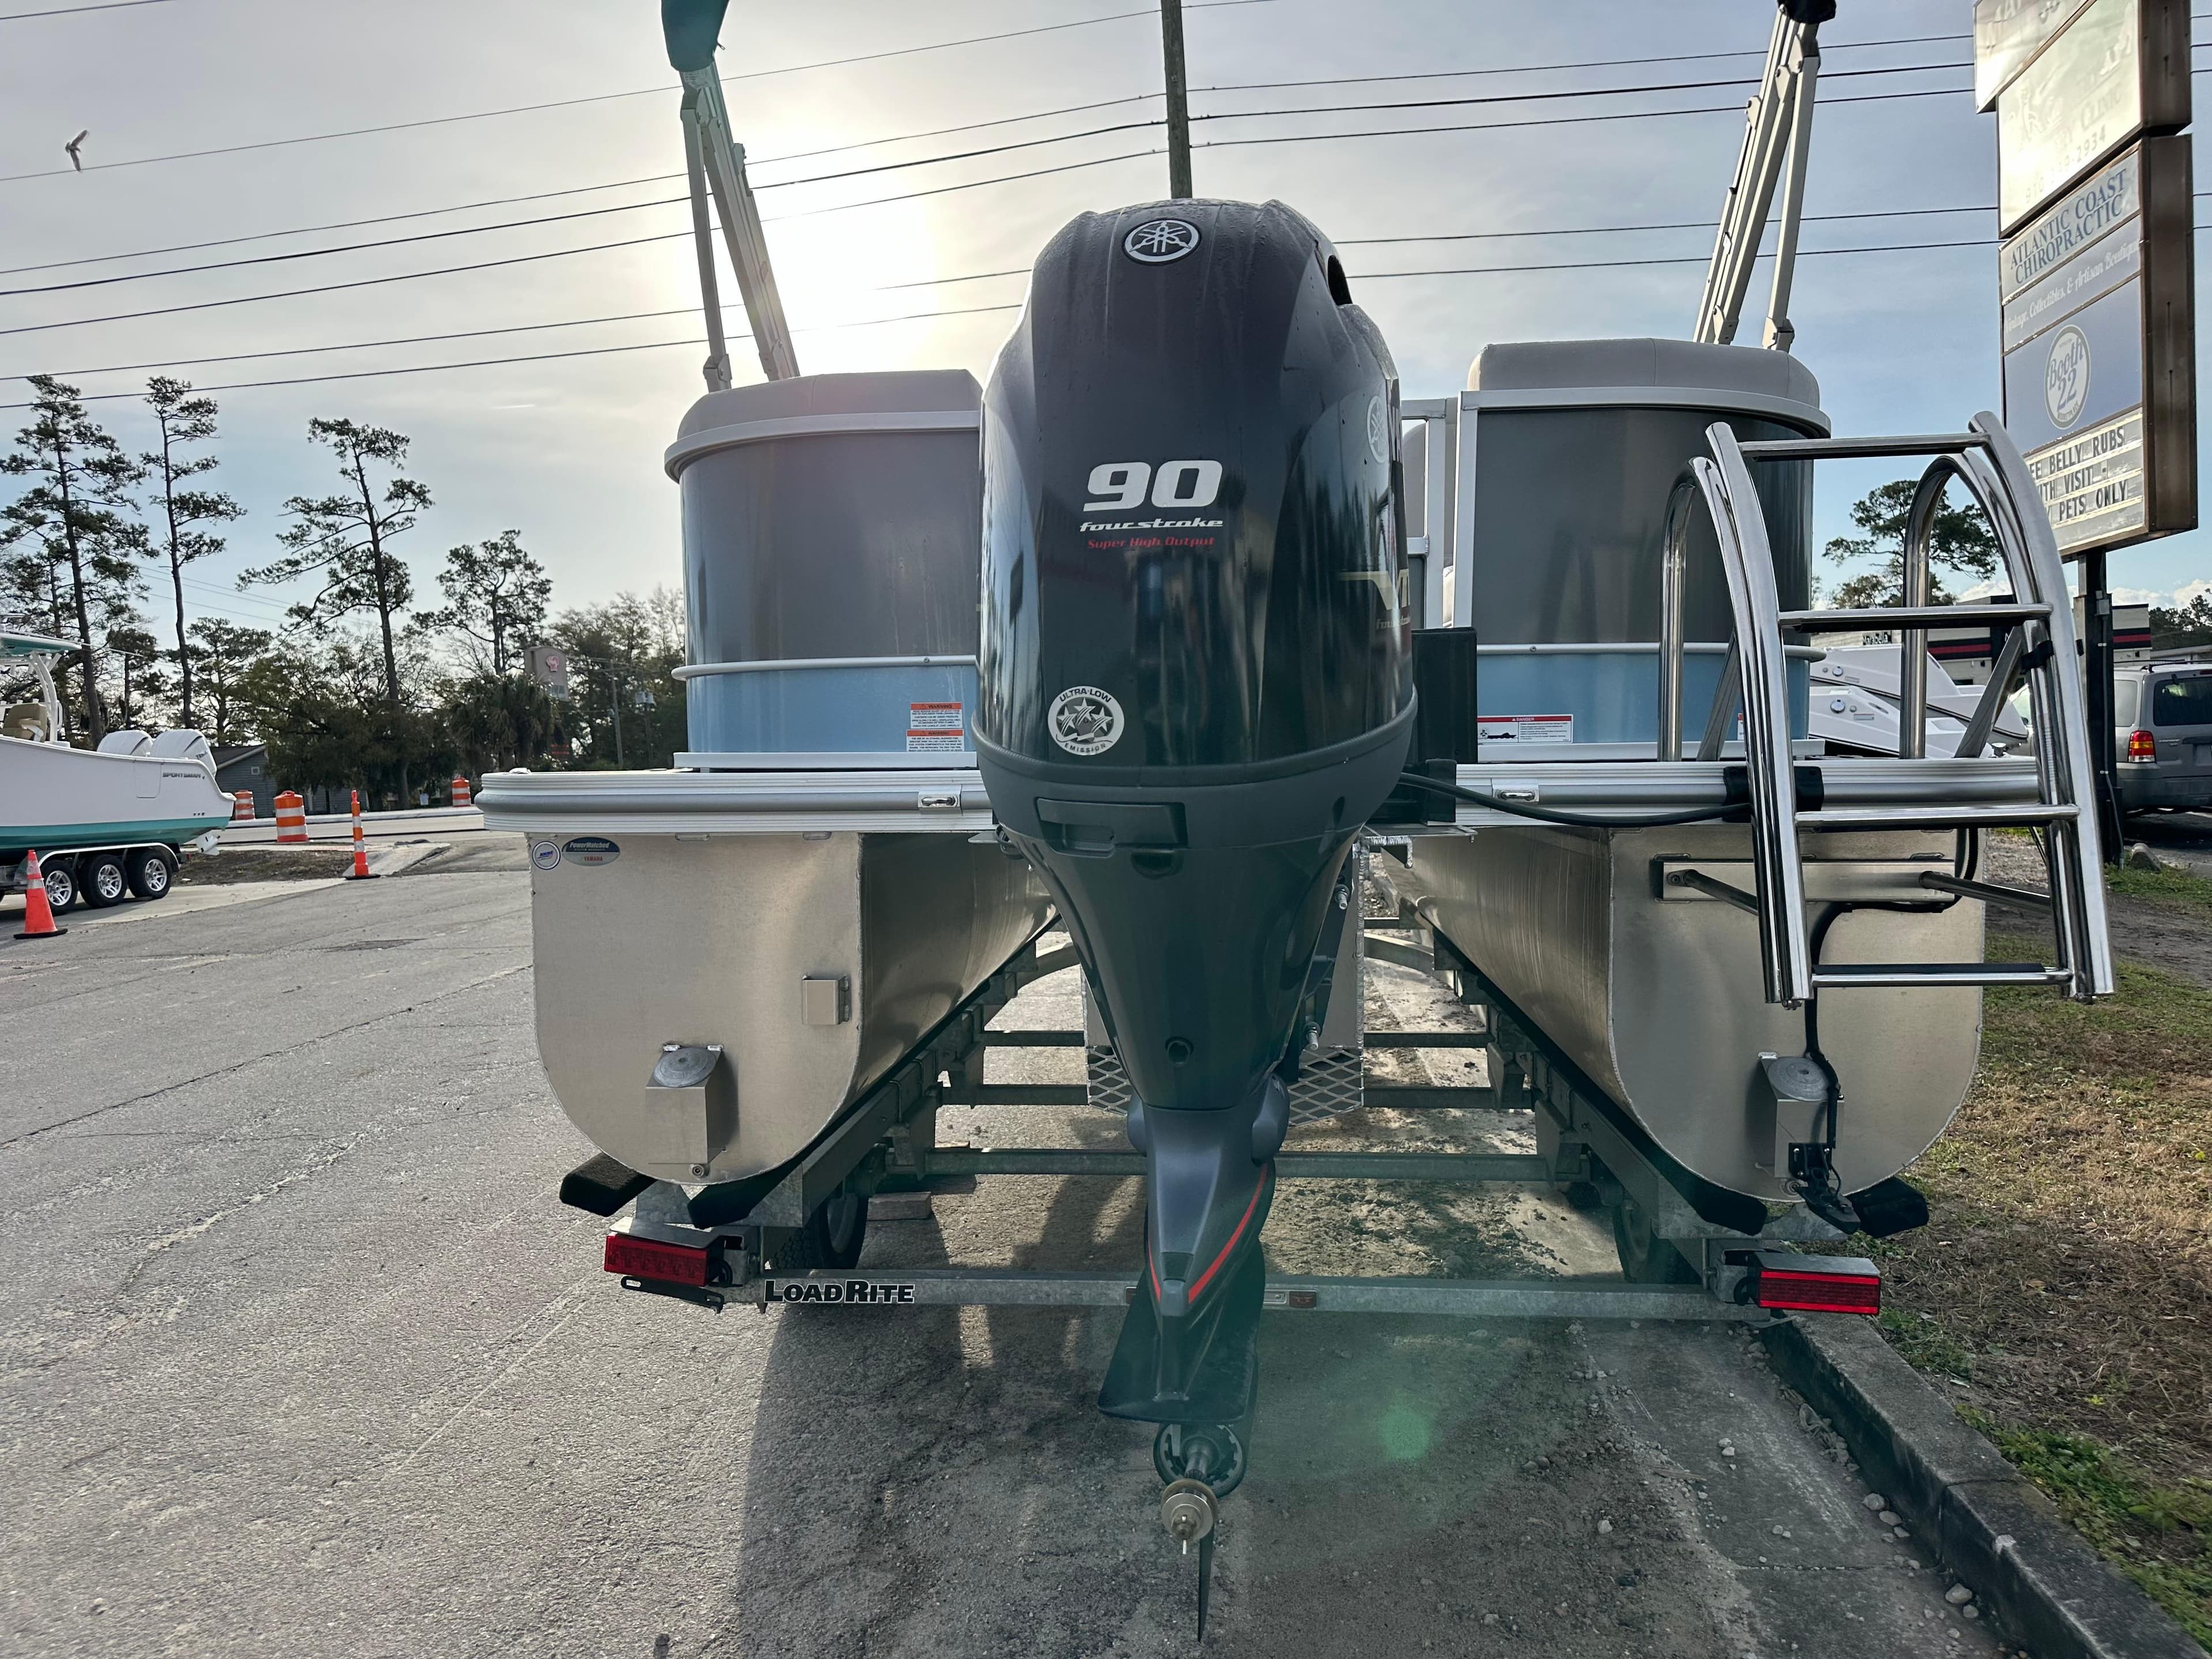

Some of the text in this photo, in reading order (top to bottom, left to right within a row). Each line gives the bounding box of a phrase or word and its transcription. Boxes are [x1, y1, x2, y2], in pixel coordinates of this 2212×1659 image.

[2010, 168, 2127, 270] ATLANTIC COAST
[2015, 194, 2123, 284] CHIROPRACTIC
[2074, 260, 2104, 291] Artisan
[2048, 337, 2084, 391] Booth
[2057, 367, 2077, 412] 22
[2049, 445, 2083, 475] BELLY
[2092, 426, 2125, 457] RUBS
[1083, 460, 1224, 512] 90
[2059, 495, 2086, 521] PETS
[2096, 479, 2128, 509] ONLY
[2063, 465, 2093, 494] VISIT
[1079, 517, 1224, 532] fourstroke
[1088, 536, 1215, 550] Super High Output
[1065, 743, 1107, 753] EMISSION
